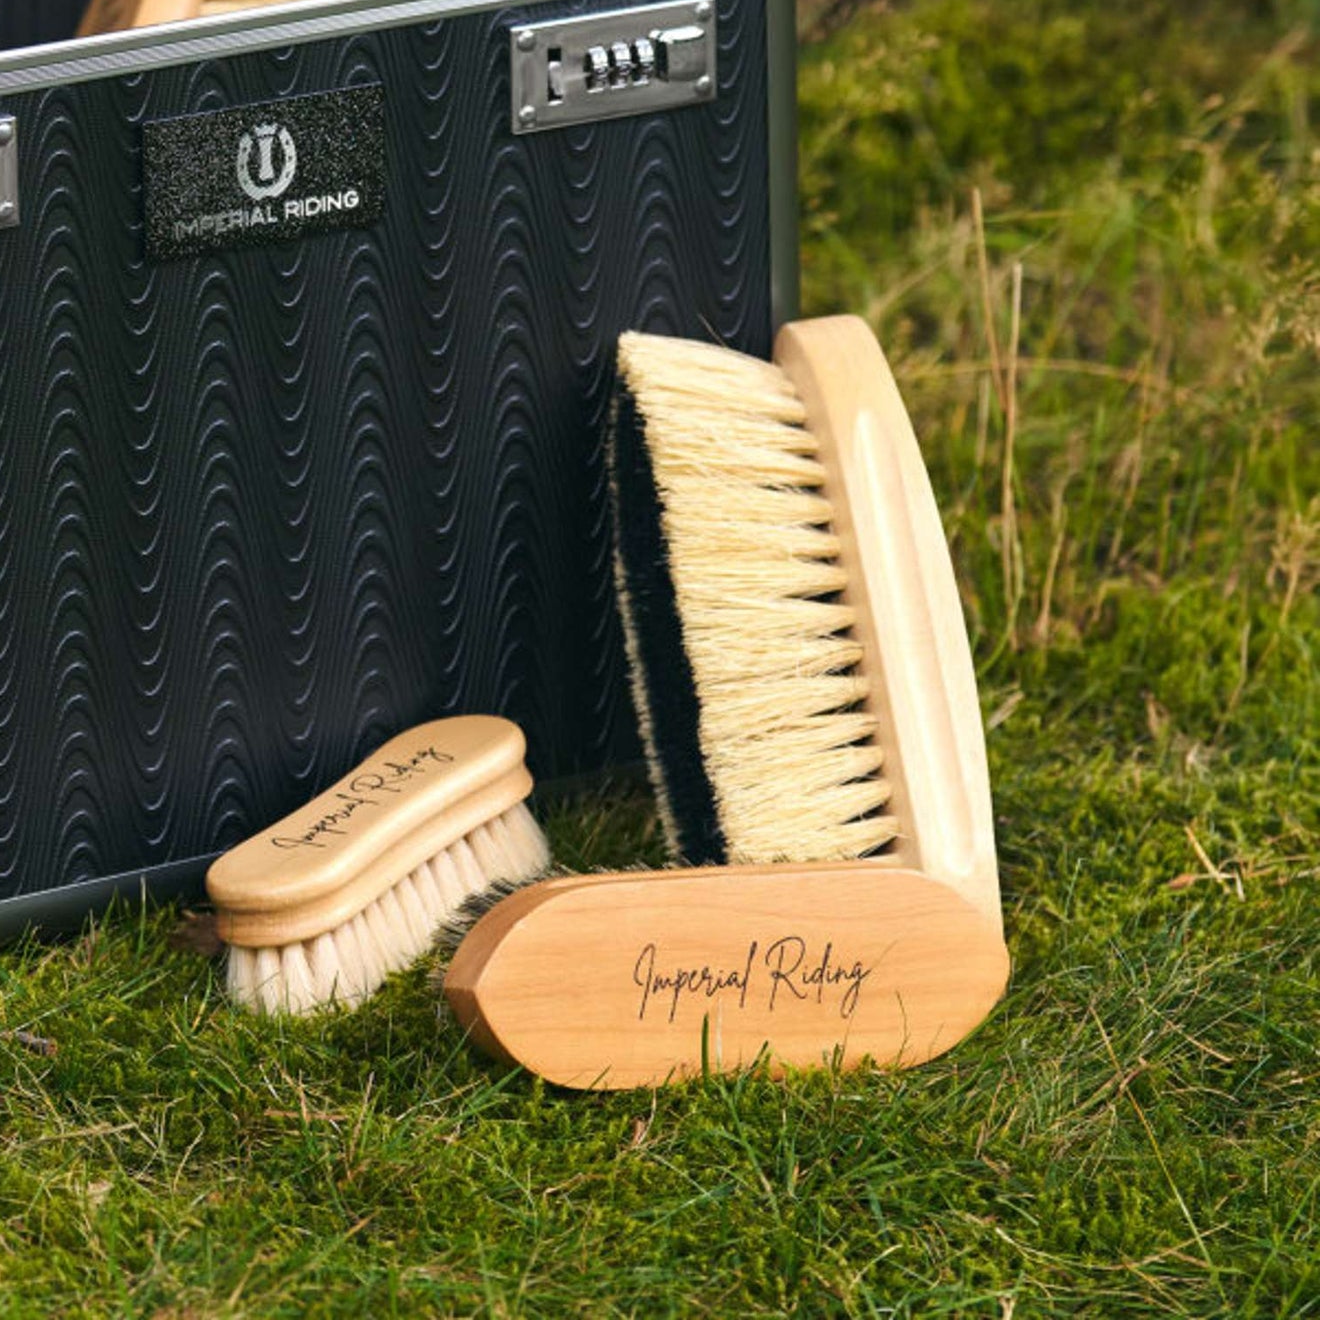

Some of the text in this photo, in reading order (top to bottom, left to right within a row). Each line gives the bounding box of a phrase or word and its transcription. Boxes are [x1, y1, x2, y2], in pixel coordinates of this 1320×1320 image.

[174, 189, 360, 240] IMPERIAL RIDING
[271, 746, 455, 849] Imperial Riding
[632, 935, 873, 1024] Imperial Riding
